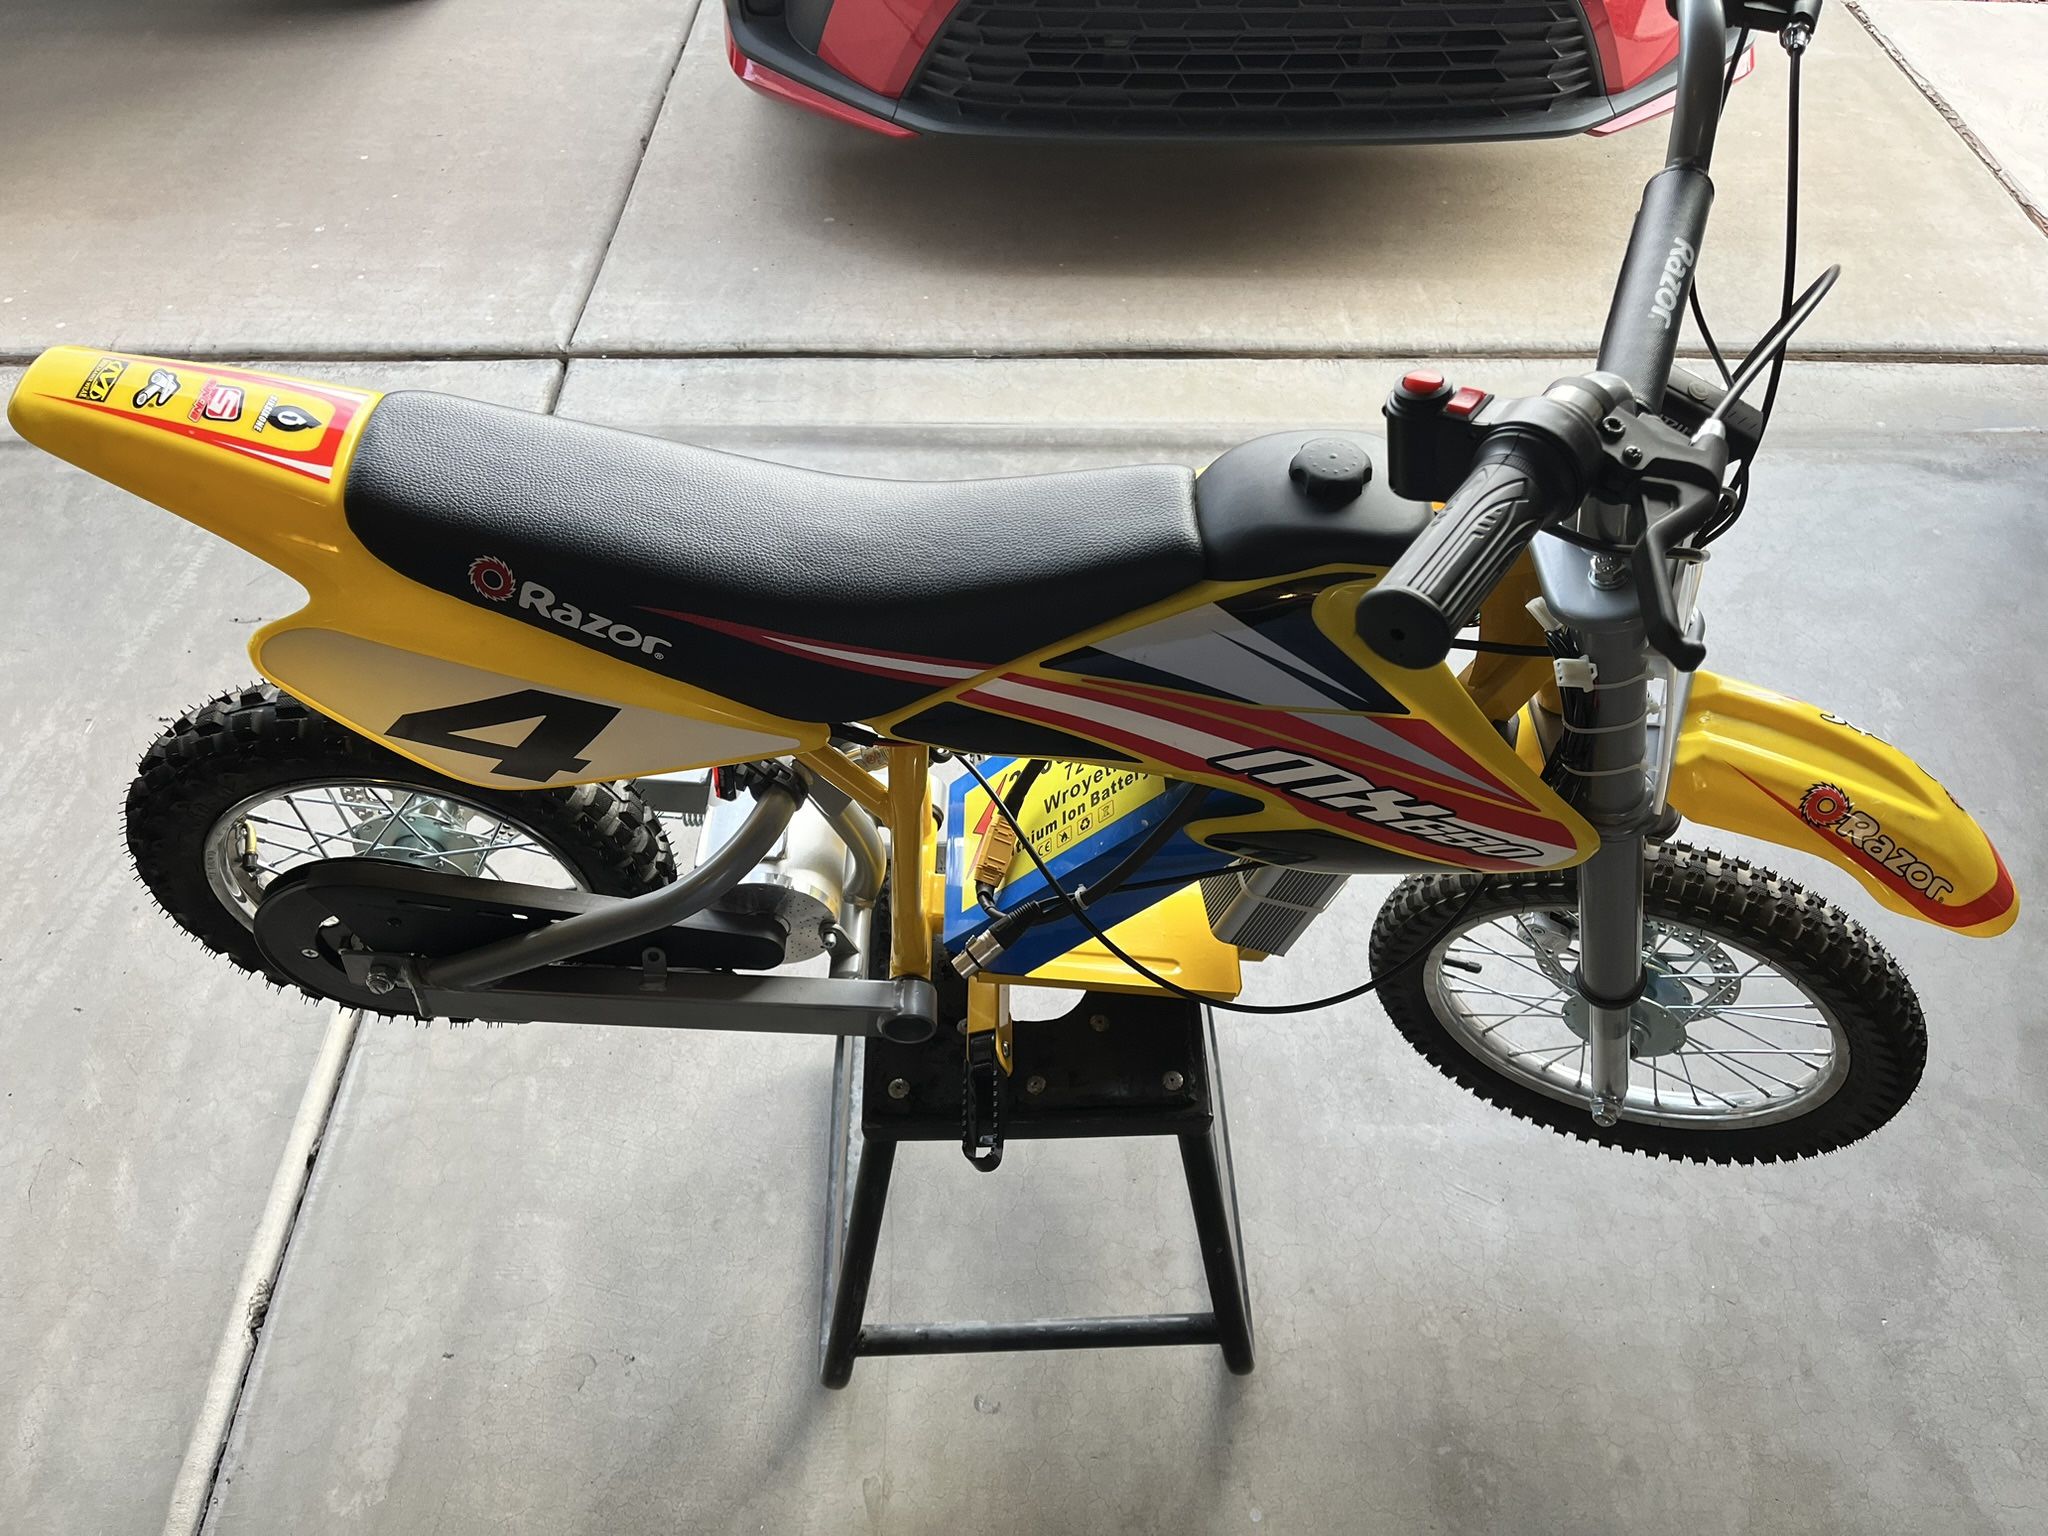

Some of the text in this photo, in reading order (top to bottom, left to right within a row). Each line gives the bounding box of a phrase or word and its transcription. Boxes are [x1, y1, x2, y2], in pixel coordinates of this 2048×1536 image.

[1650, 236, 1695, 330] Razor
[518, 580, 673, 655] Razor
[384, 688, 622, 783] 4
[1062, 802, 1086, 825] Ion
[1835, 810, 1954, 900] Razor
